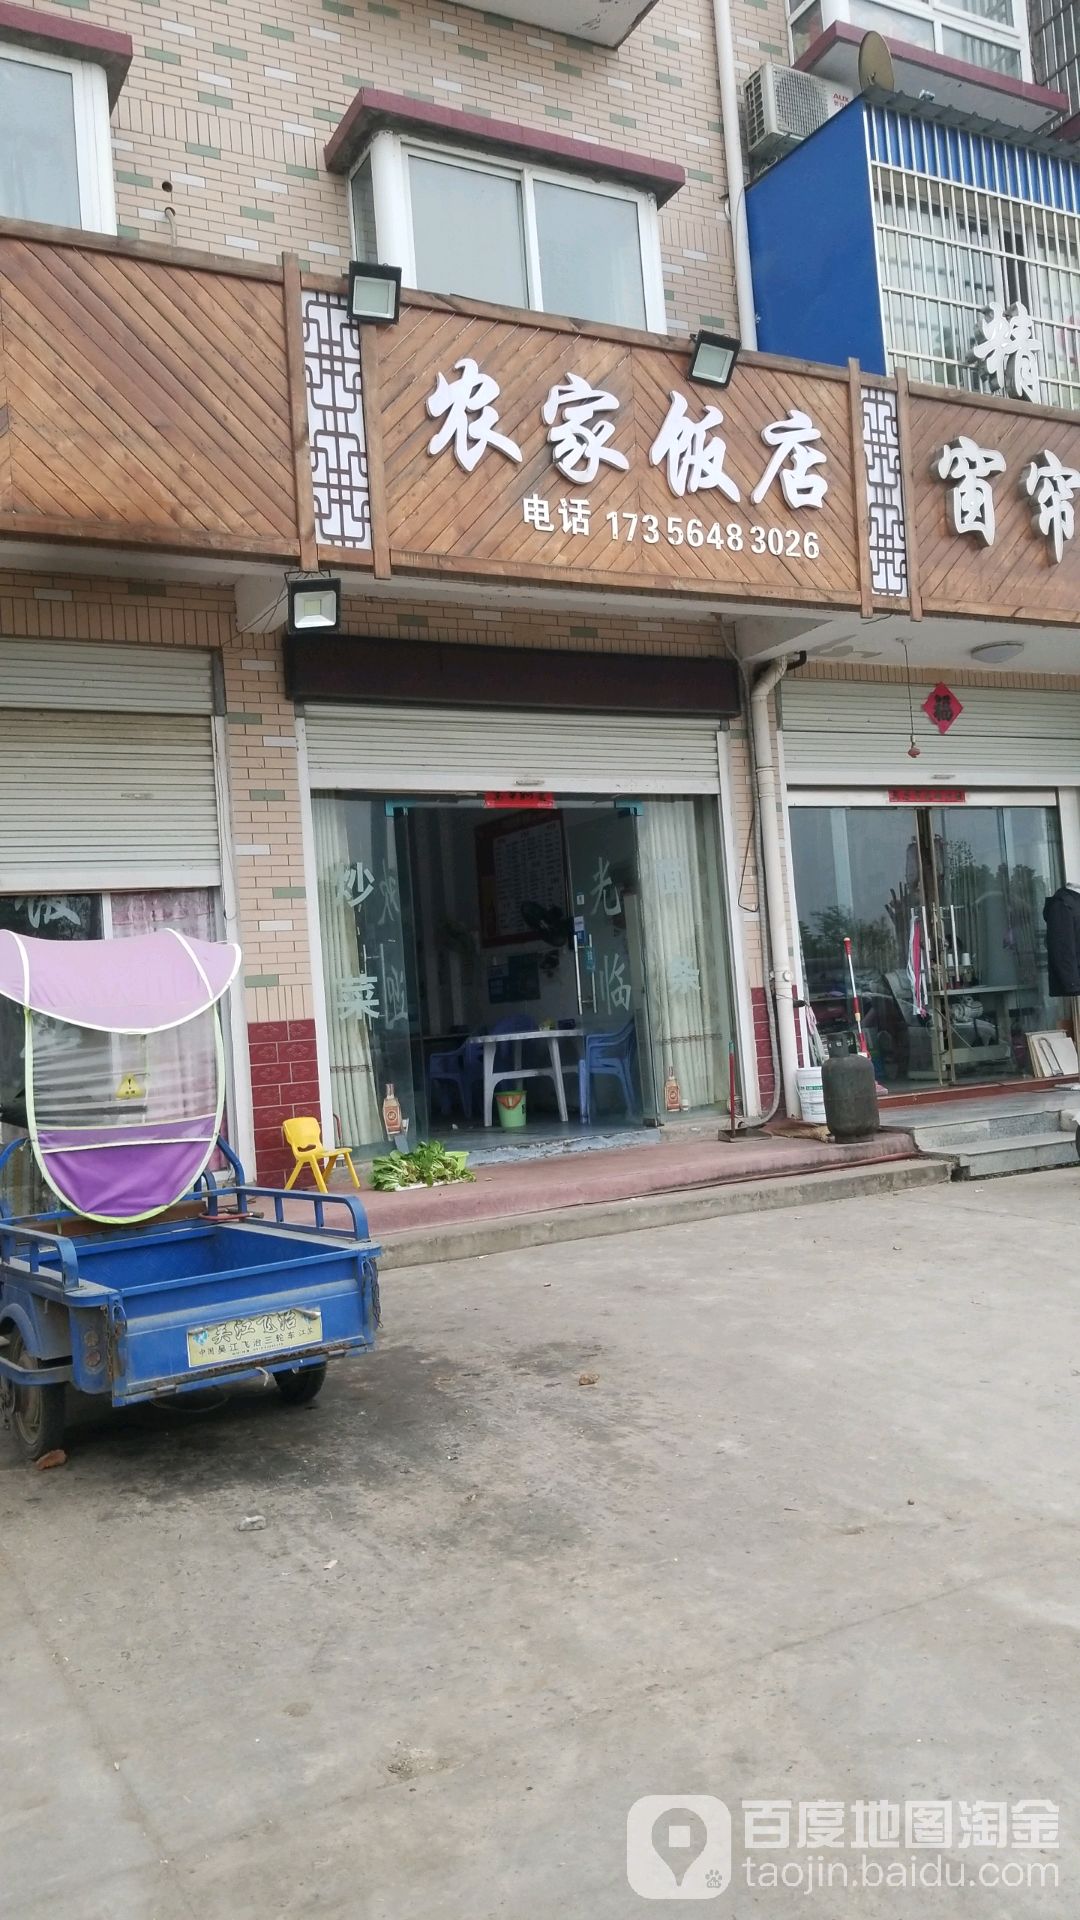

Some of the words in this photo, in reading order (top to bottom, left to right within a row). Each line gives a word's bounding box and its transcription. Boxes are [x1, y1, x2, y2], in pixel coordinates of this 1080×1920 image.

[973, 302, 1042, 404] 精
[426, 358, 828, 510] 农家饭店
[523, 493, 592, 536] 电话
[937, 435, 1080, 566] 窗帘
[590, 857, 632, 1015] 光临
